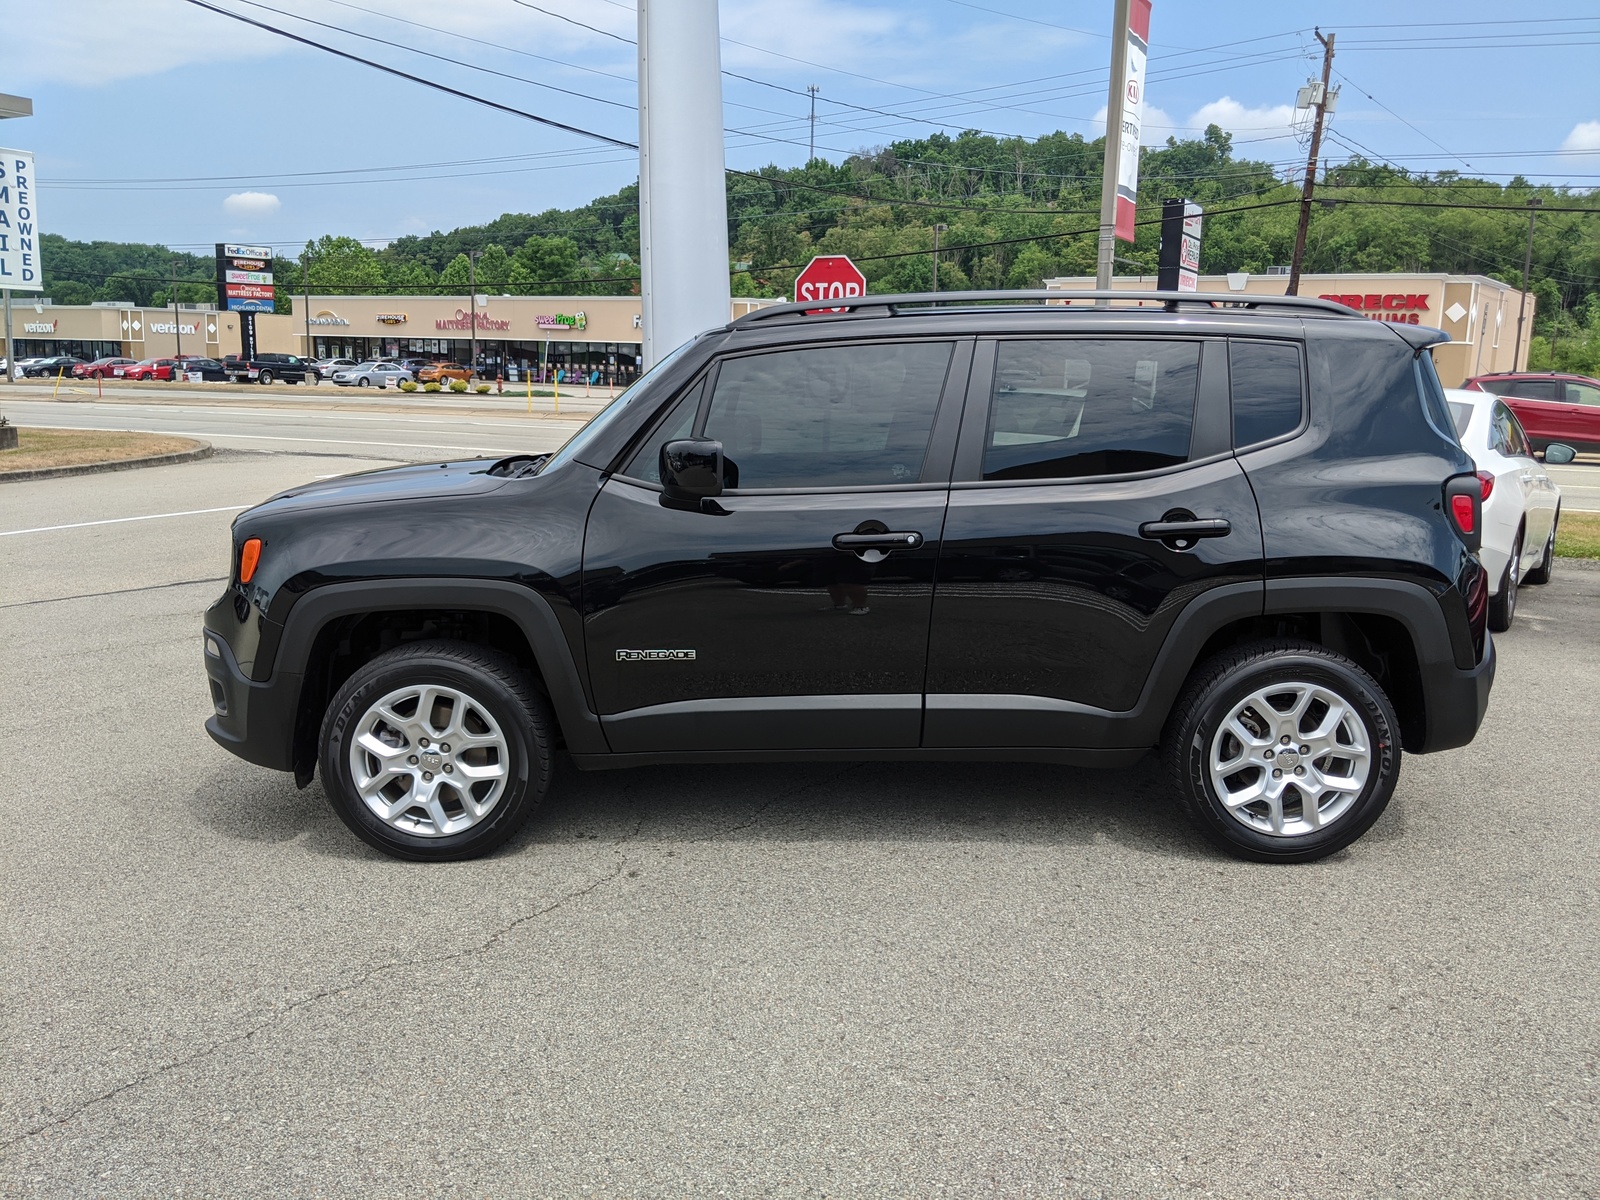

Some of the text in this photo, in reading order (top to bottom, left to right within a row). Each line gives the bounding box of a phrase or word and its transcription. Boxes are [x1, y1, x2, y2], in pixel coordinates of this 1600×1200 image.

[15, 160, 34, 281] PREOWNED
[227, 247, 246, 255] FedEx
[801, 281, 860, 312] STOP
[24, 321, 54, 334] verizon
[476, 320, 511, 331] FACTORY
[616, 649, 696, 661] RENEGADE
